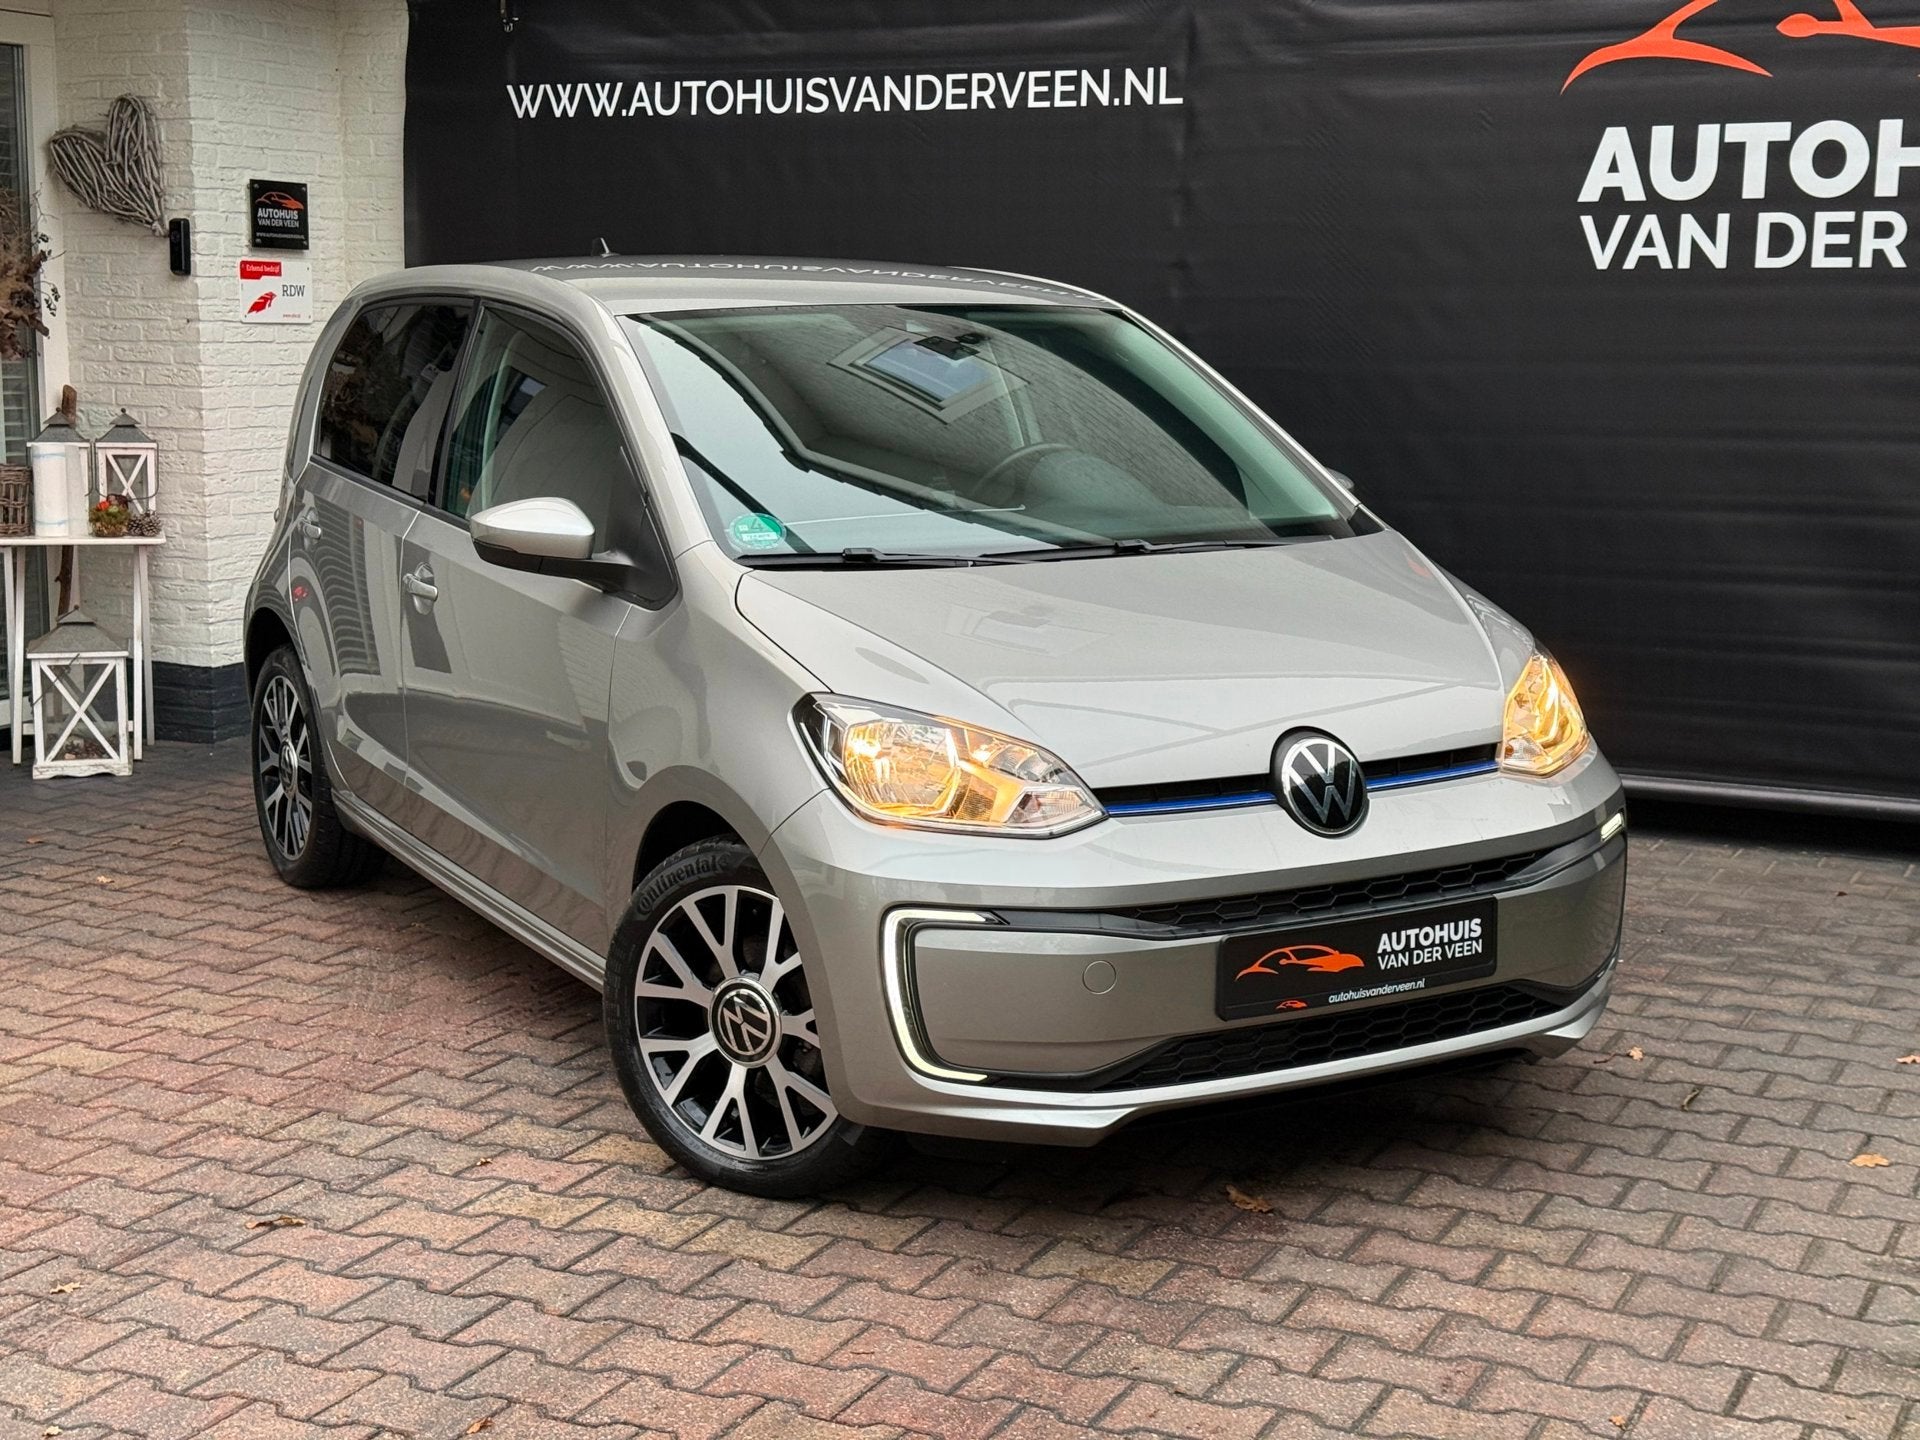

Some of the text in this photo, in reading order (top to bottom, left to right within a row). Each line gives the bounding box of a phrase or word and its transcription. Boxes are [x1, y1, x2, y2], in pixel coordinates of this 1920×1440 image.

[506, 66, 1184, 119] WWW.AUTOHUISVANDERVEEN.NL
[257, 208, 299, 220] AUTOHUIS
[271, 219, 283, 227] DER
[284, 220, 299, 228] VEEN
[1580, 211, 1908, 270] VAN DER
[282, 284, 305, 297] RDW
[1377, 918, 1482, 954] AUTOHUIS
[1377, 939, 1483, 970] VAN DER VEEN
[1328, 978, 1426, 1004] autohuisvanderveen.nl
